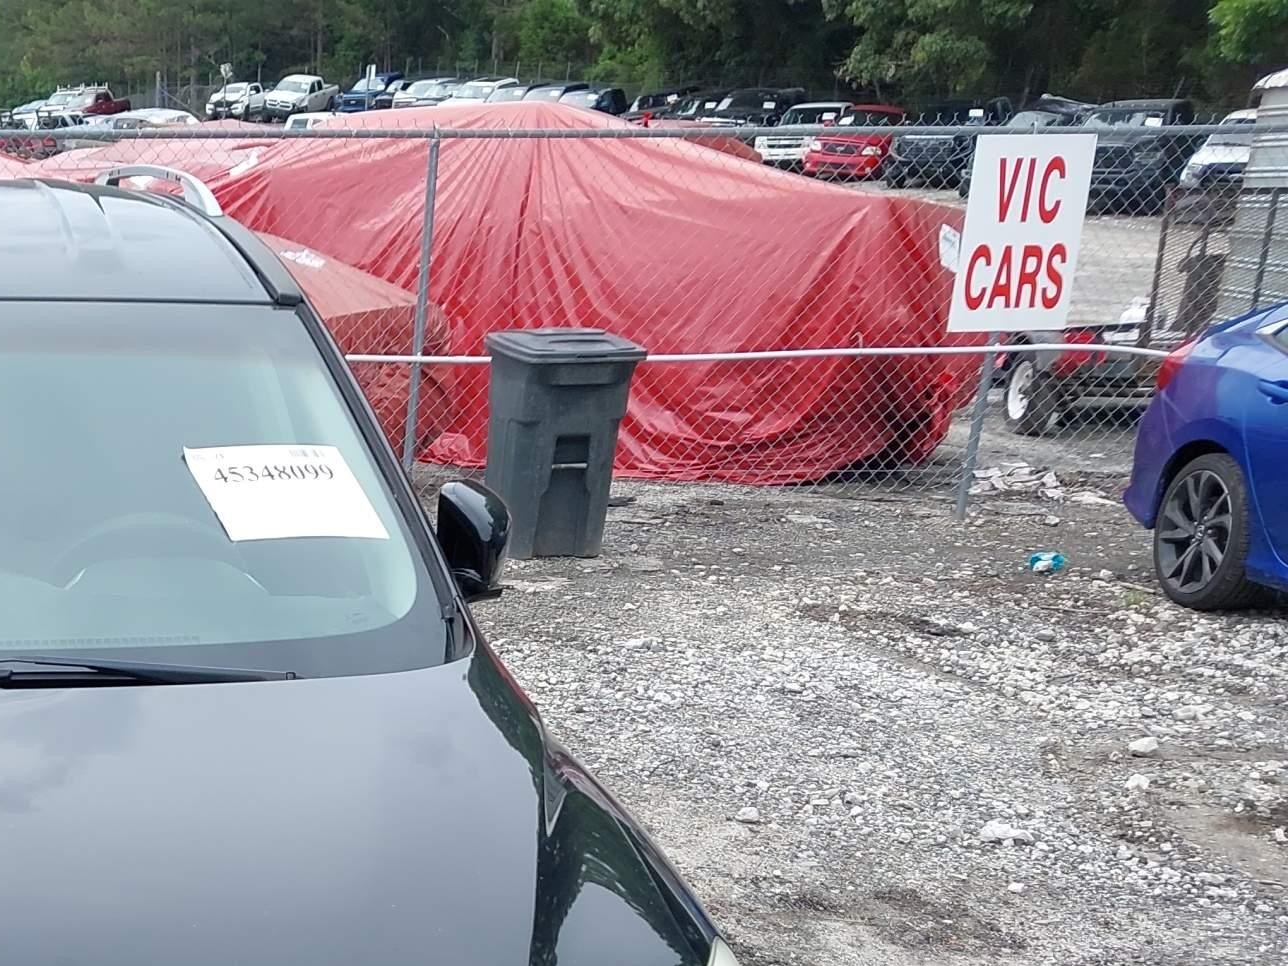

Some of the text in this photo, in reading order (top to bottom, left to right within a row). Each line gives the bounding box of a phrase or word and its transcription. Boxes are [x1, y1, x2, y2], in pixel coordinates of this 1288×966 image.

[998, 156, 1067, 224] VIC
[964, 243, 1067, 311] CARS
[214, 464, 334, 483] 45348099
